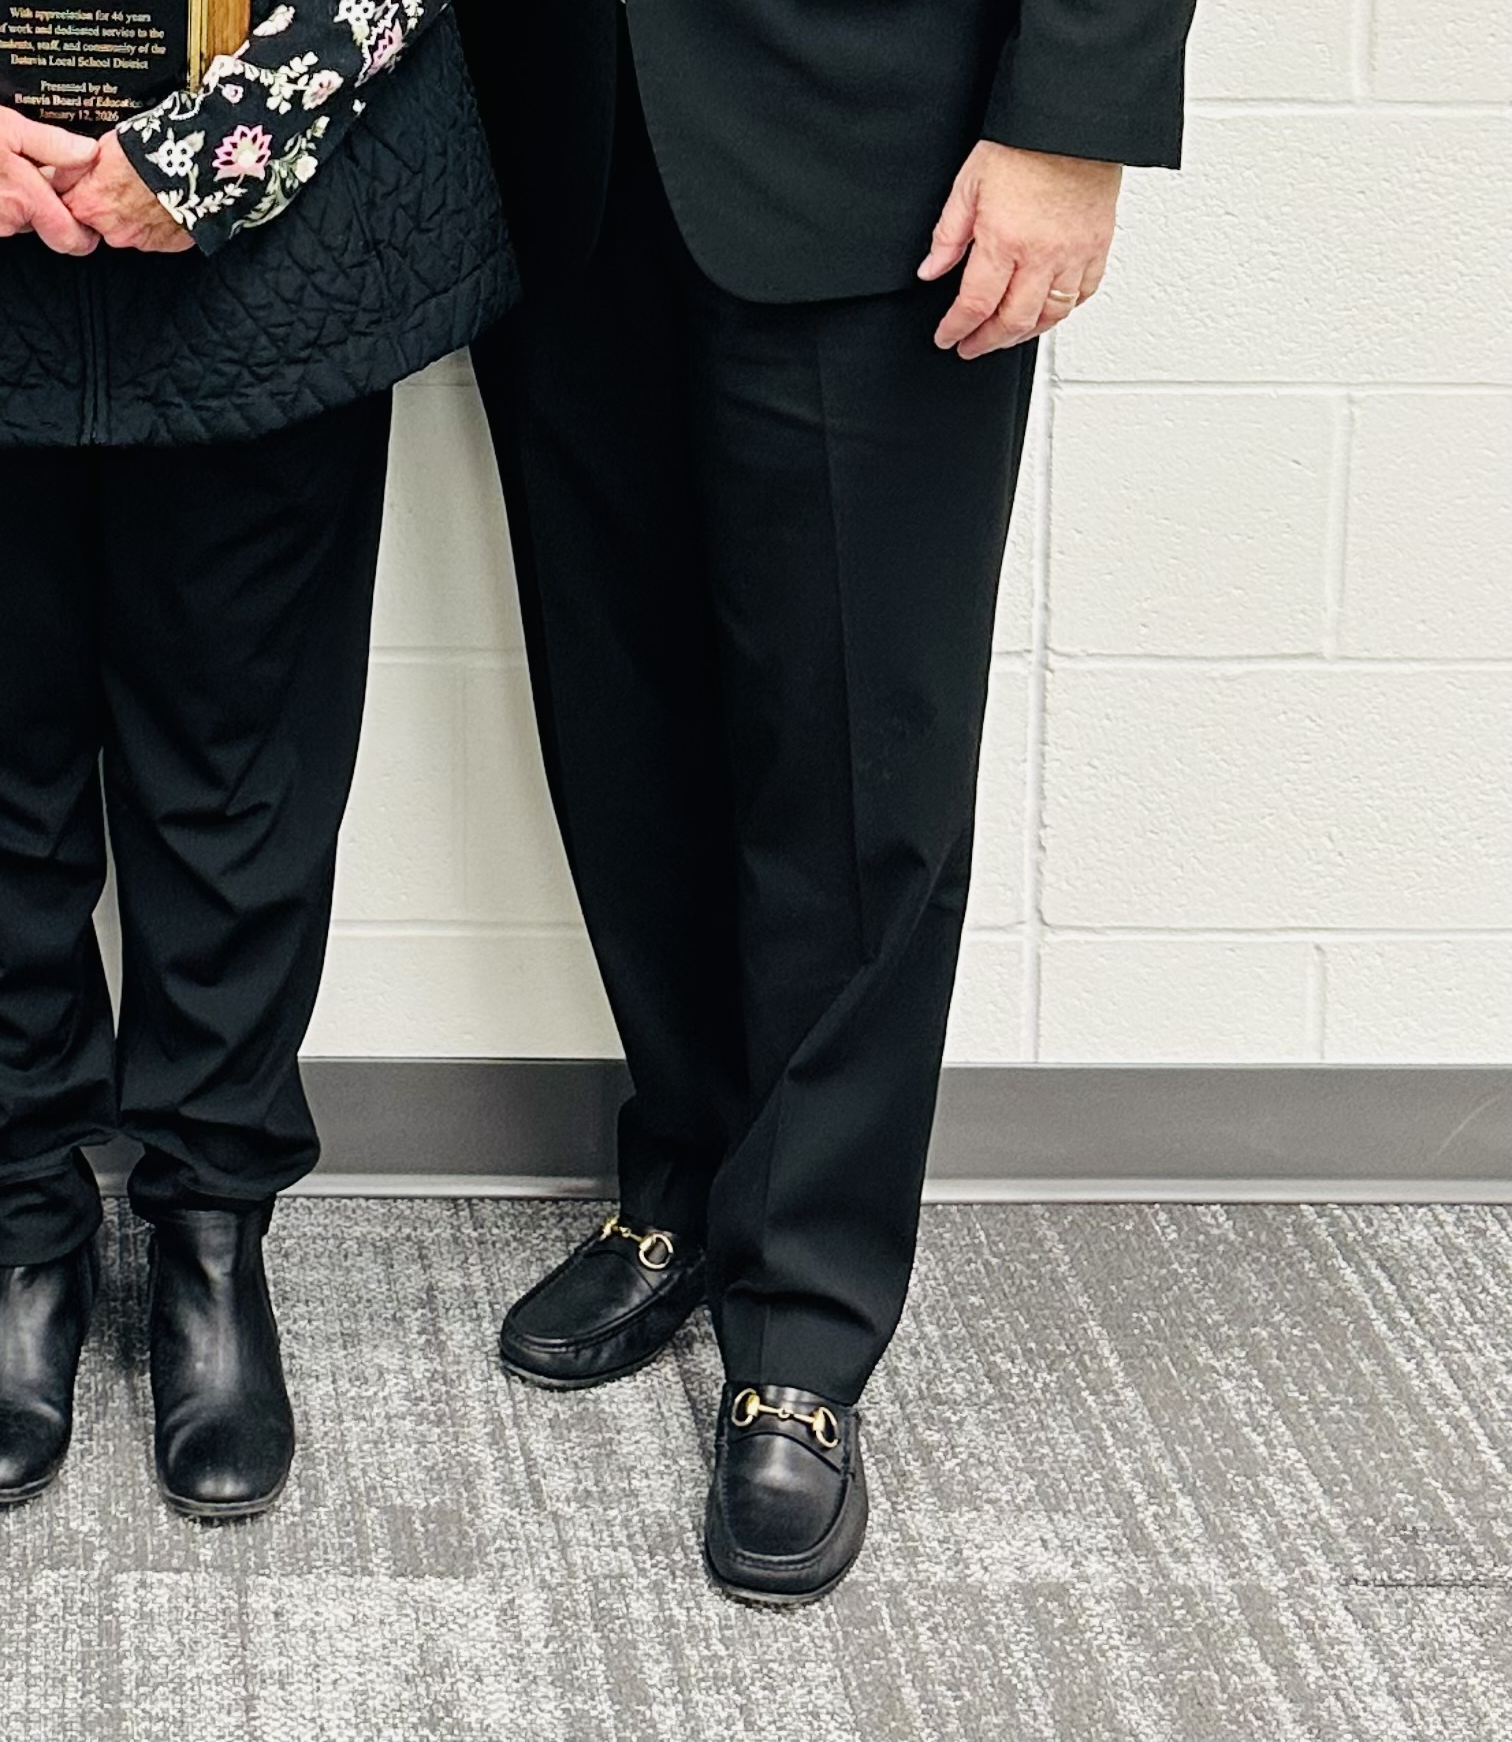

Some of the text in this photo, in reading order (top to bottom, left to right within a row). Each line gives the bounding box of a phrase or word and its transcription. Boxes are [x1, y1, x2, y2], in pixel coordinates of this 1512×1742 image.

[9, 7, 151, 24] With appreciation for 46 years
[8, 23, 33, 34] work
[35, 24, 52, 35] and
[54, 25, 100, 36] dedicated
[102, 27, 136, 38] service
[137, 28, 147, 38] to
[149, 28, 165, 39] the
[37, 39, 61, 52] staff,
[62, 40, 81, 52] and
[82, 42, 137, 56] community
[137, 43, 150, 54] of
[151, 43, 166, 55] the
[10, 53, 149, 69] Batavia Local School District
[40, 80, 118, 95] Presented by the
[14, 93, 51, 105] Batavia
[52, 94, 81, 107] Board
[83, 95, 95, 107] of
[38, 108, 75, 122] January
[95, 110, 119, 122] 2026
